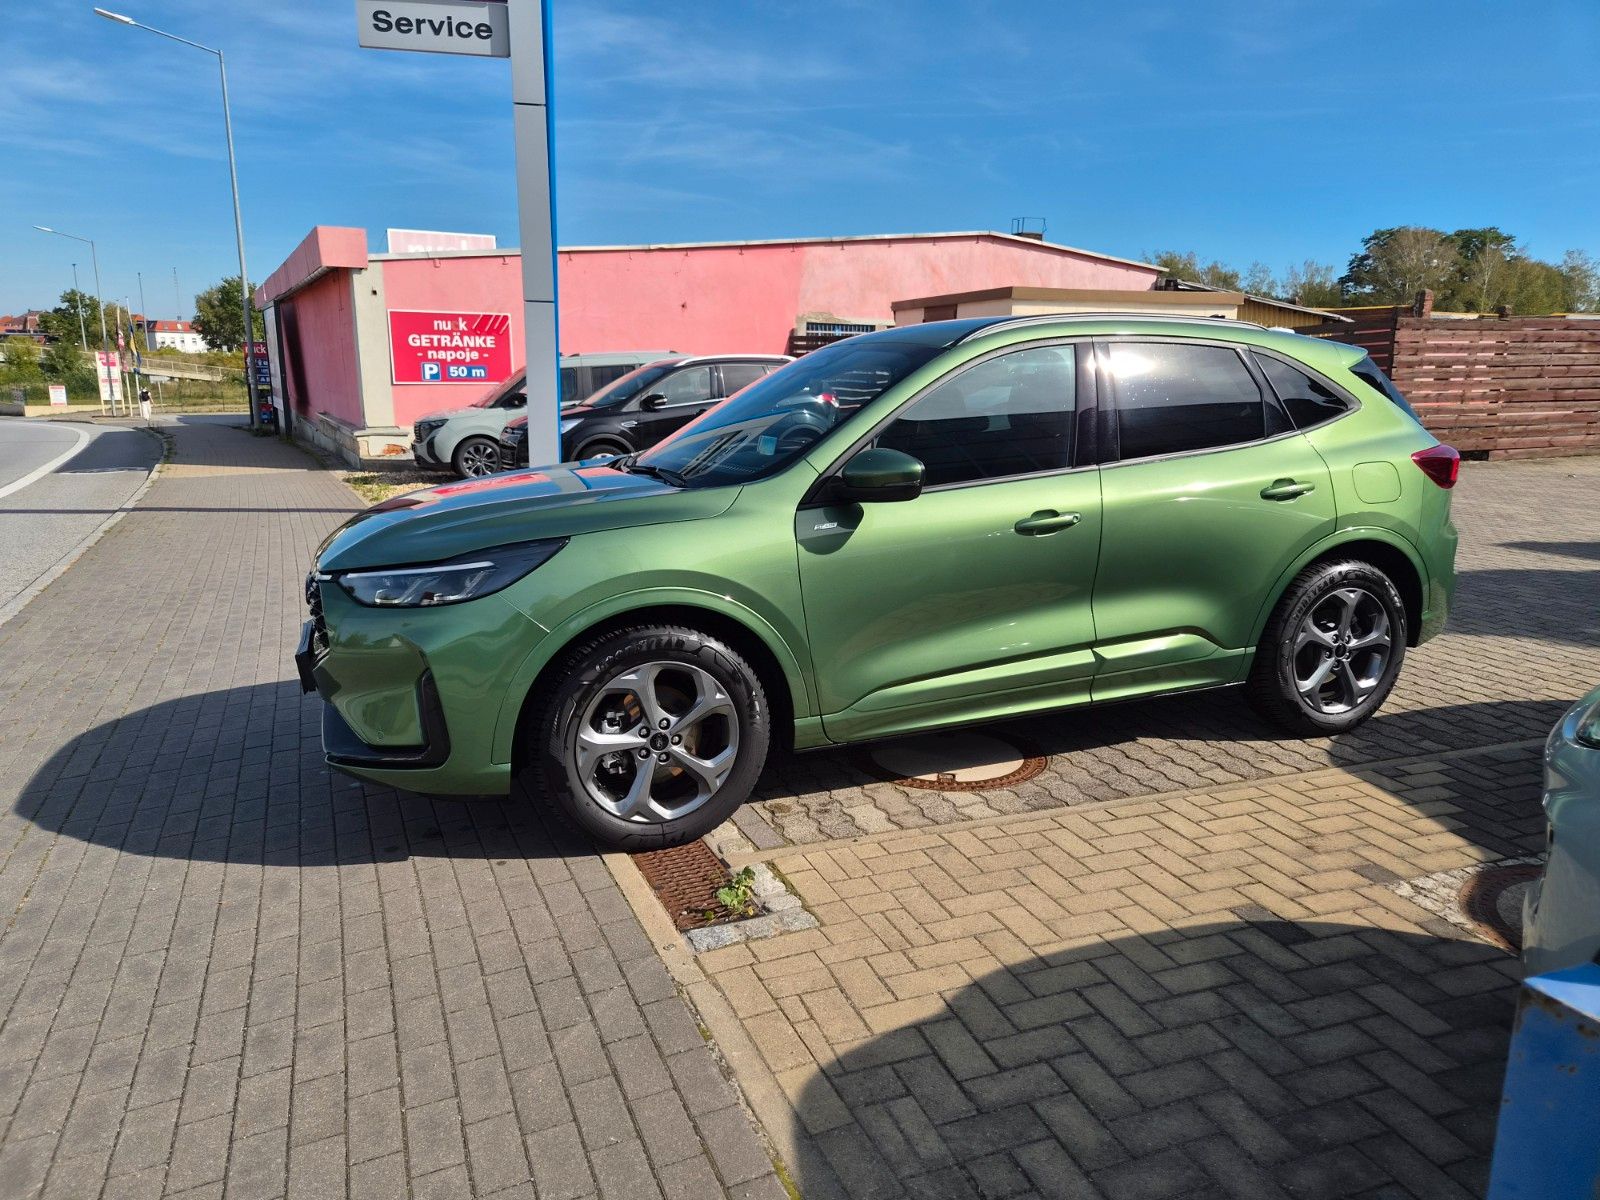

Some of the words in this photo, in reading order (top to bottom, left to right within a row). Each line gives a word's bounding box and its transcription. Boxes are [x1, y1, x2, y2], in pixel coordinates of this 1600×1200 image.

[372, 10, 493, 40] Service
[407, 332, 496, 348] GETRÄNKE
[424, 364, 439, 379] P
[449, 366, 467, 377] 50
[471, 368, 485, 377] m
